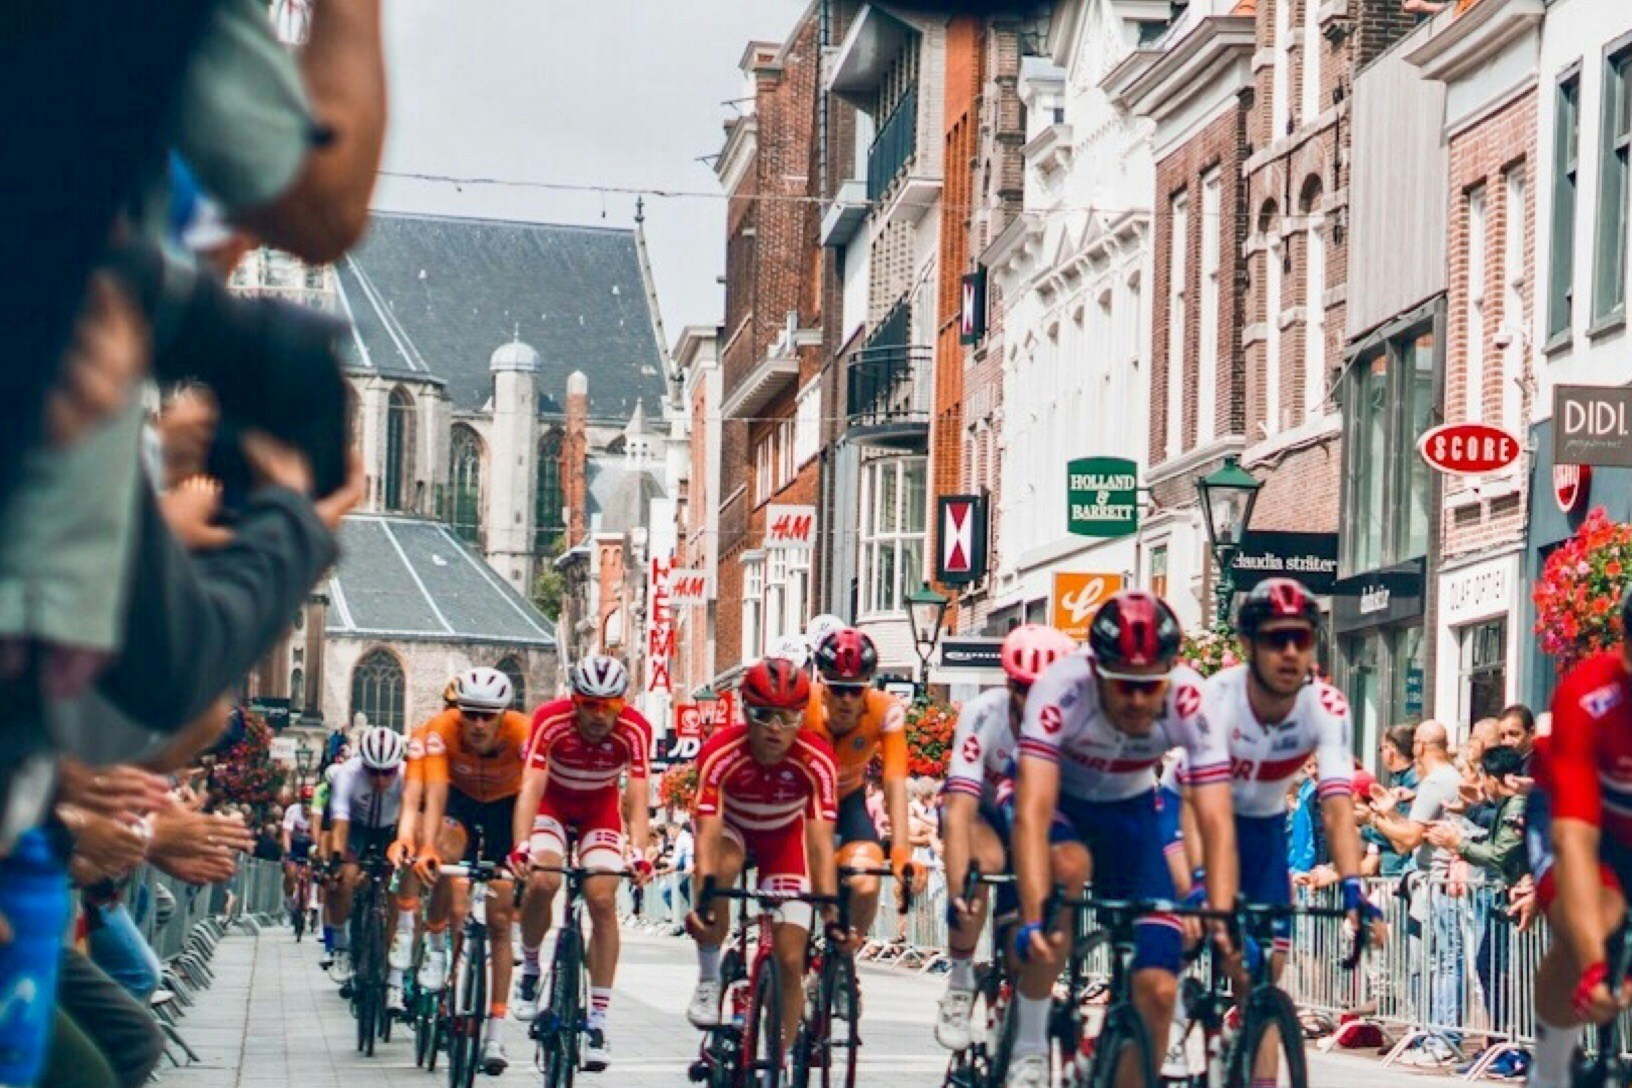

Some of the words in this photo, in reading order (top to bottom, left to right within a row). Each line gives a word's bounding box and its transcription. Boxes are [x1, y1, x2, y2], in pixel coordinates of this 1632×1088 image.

[1434, 435, 1511, 462] SCORE
[1070, 474, 1135, 491] HOLLAND
[1095, 490, 1110, 505] &
[1071, 504, 1133, 521] BARRETT
[649, 556, 677, 693] HEMA
[668, 737, 701, 758] JD
